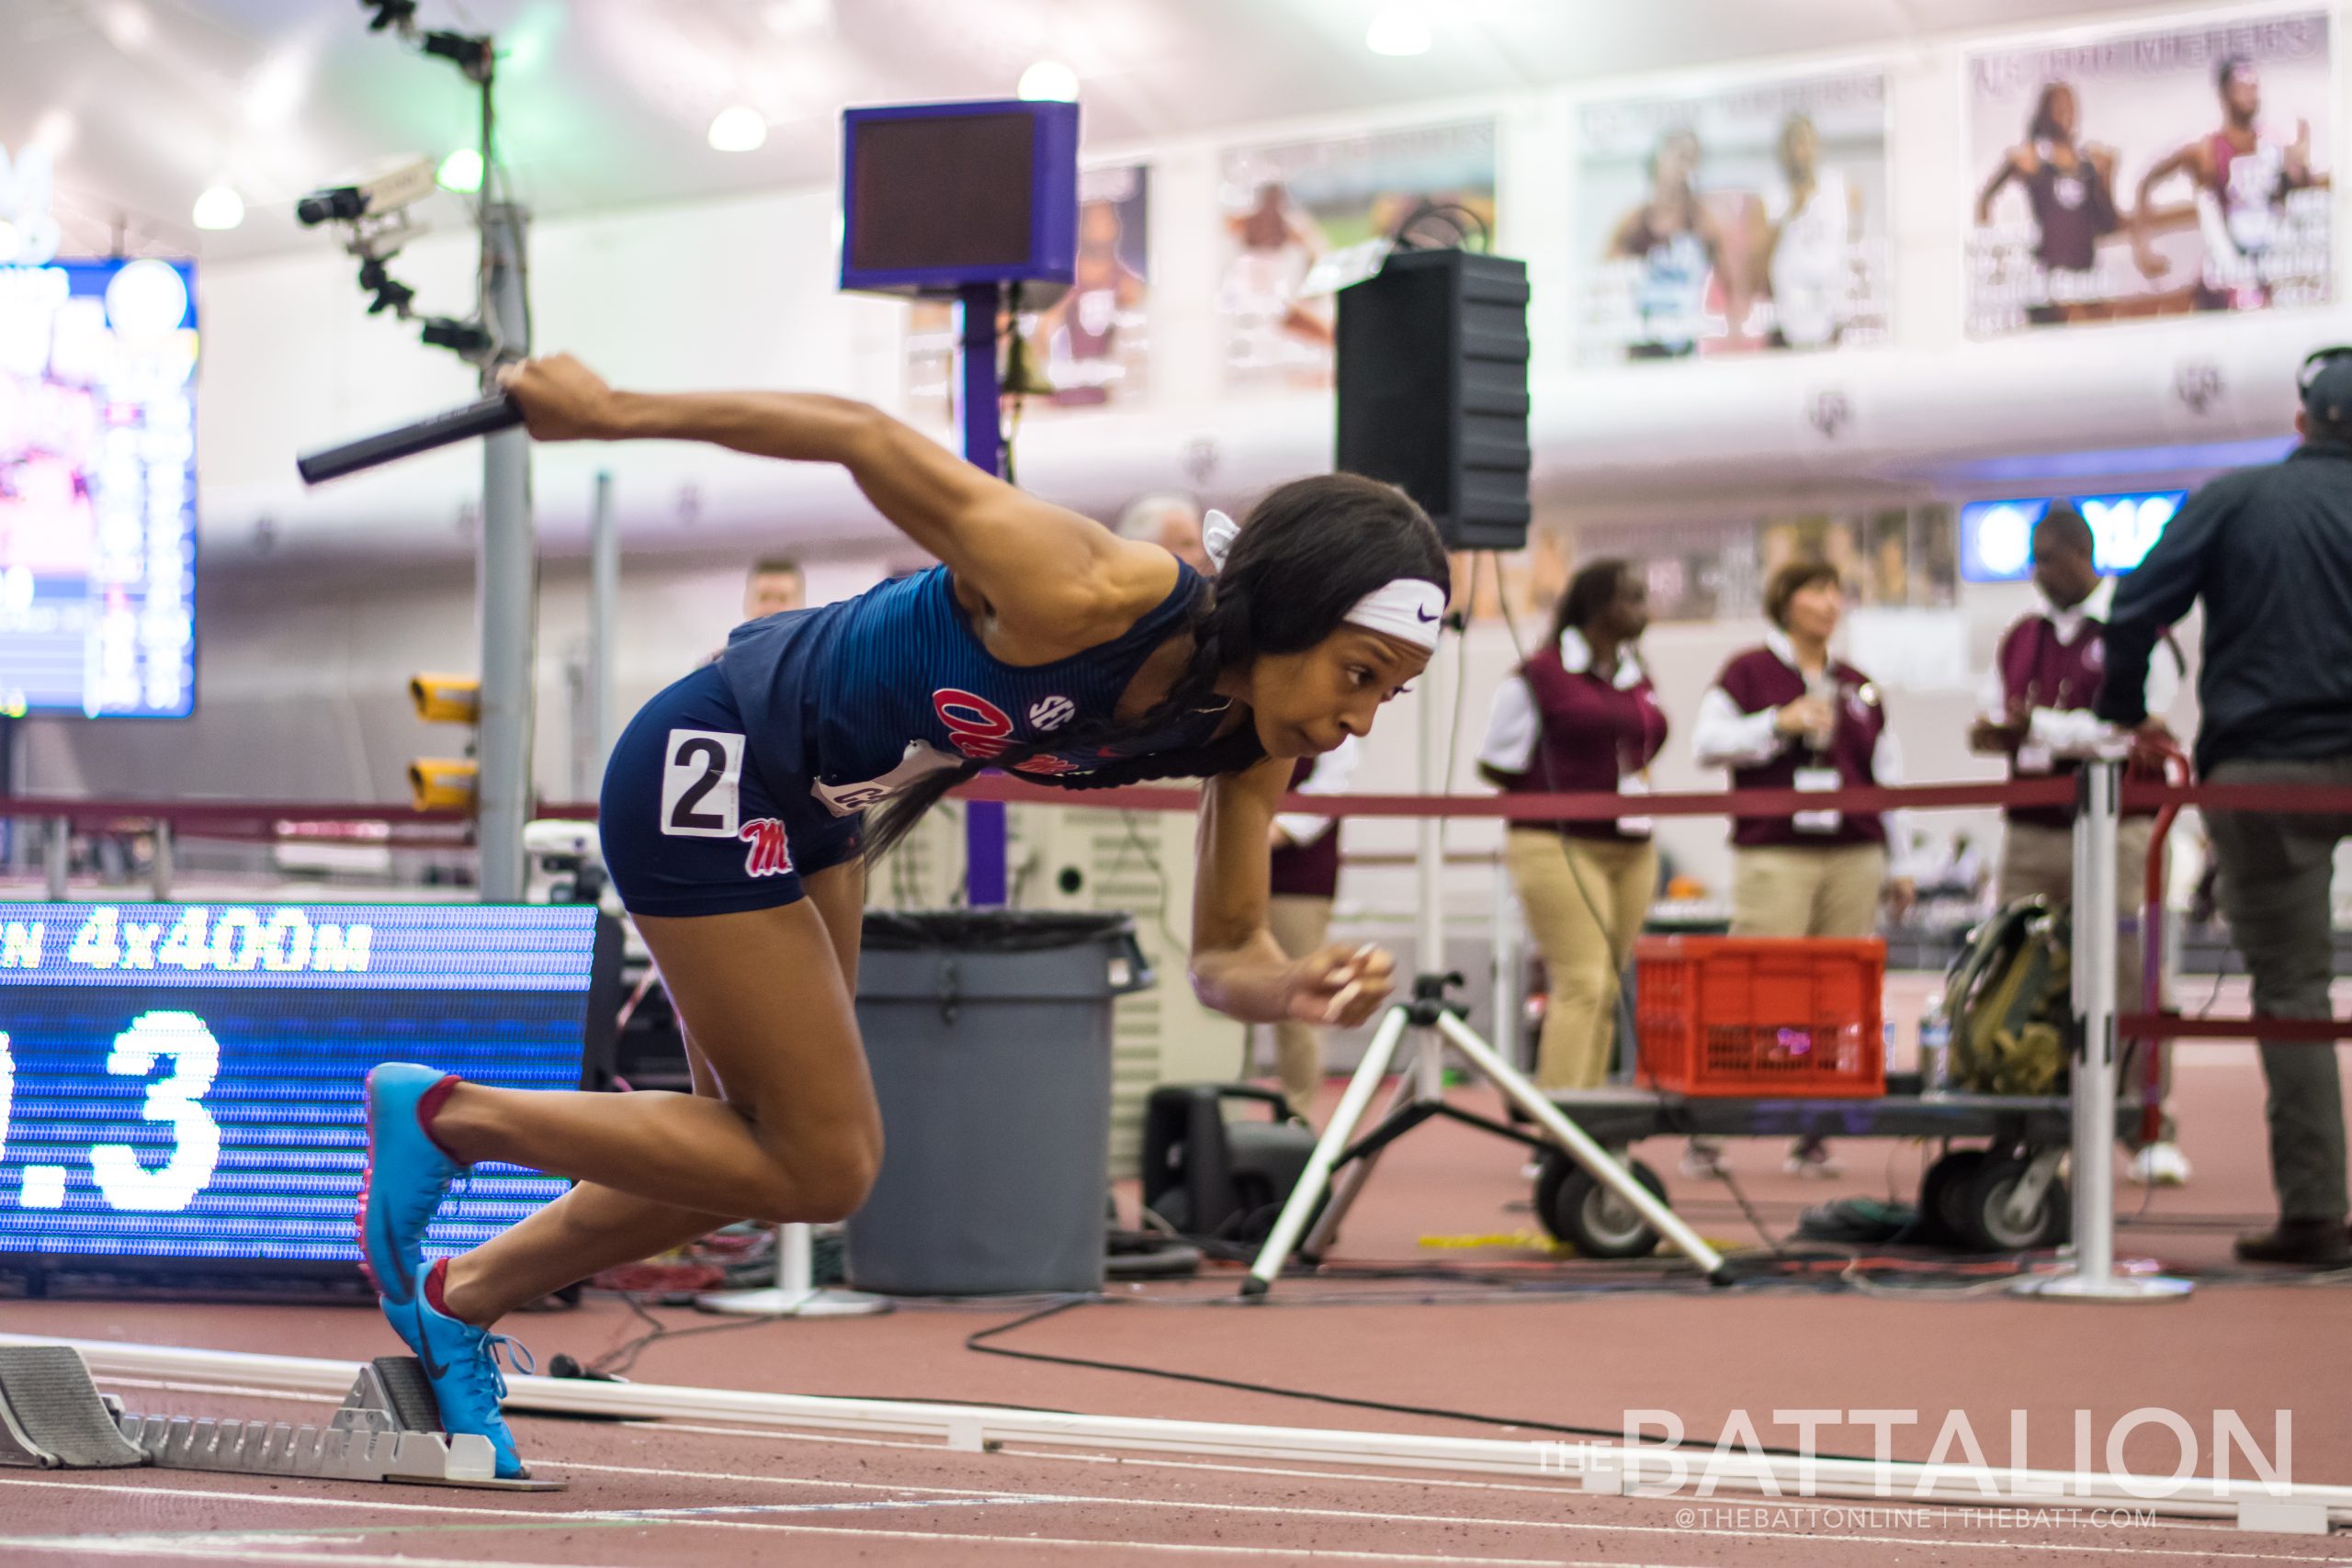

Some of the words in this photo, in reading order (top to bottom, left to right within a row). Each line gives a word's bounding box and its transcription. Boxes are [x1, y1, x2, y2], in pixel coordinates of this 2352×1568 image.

[1029, 695, 1075, 731] SEC
[671, 738, 725, 829] 2
[0, 922, 44, 969] N
[0, 1010, 220, 1211] .3
